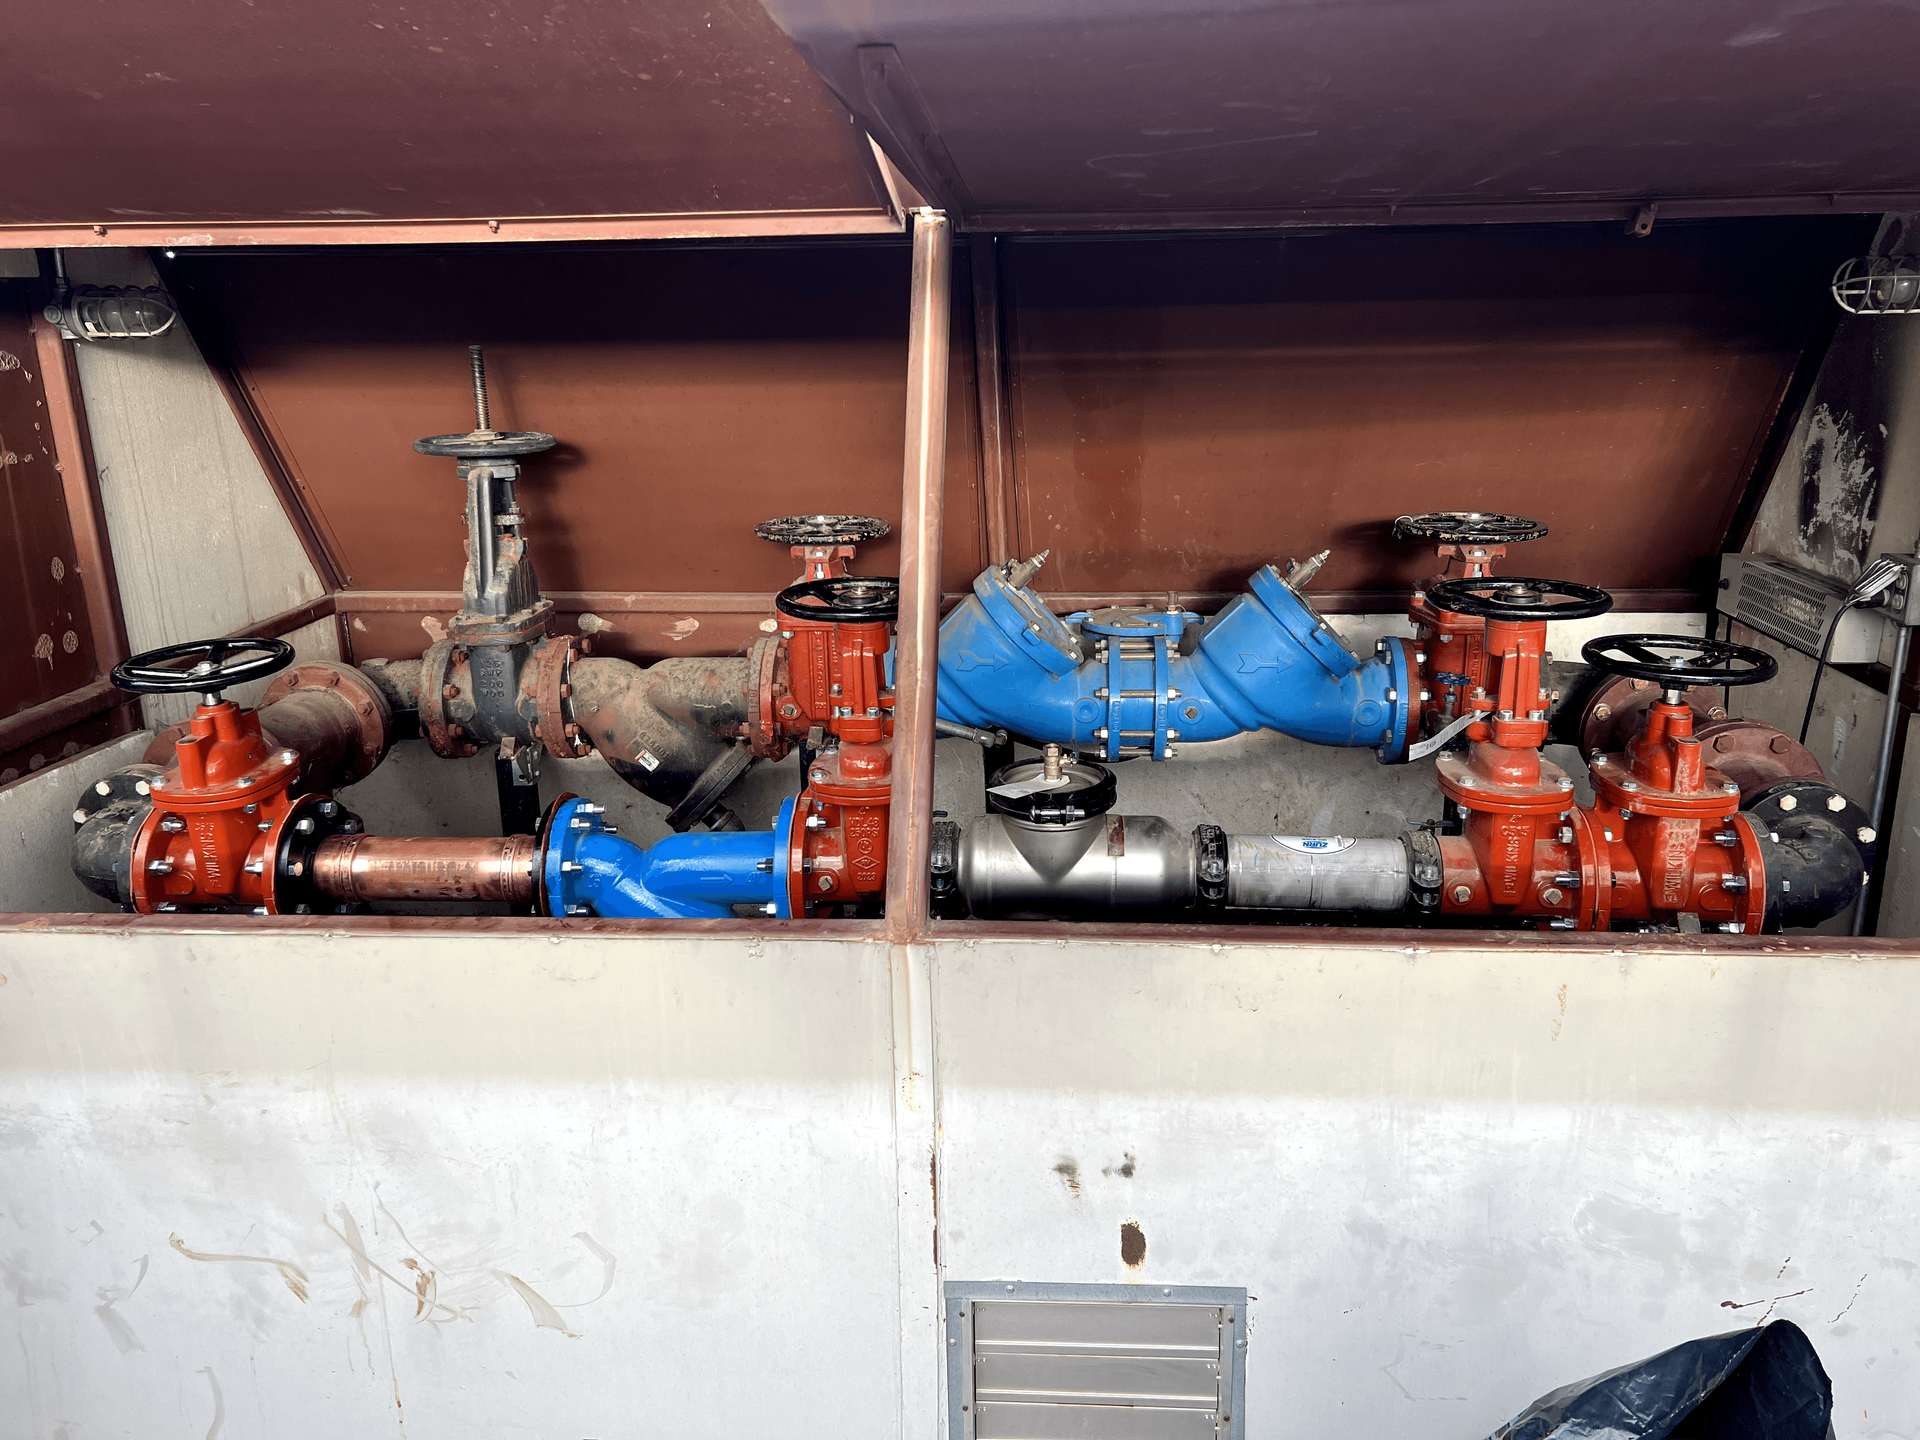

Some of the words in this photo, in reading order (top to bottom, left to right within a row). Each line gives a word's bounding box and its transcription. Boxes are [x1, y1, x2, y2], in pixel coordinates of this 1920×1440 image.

[200, 832, 221, 879] WILKINS
[1504, 836, 1519, 882] WILKINS
[1664, 842, 1686, 890] WILKINS
